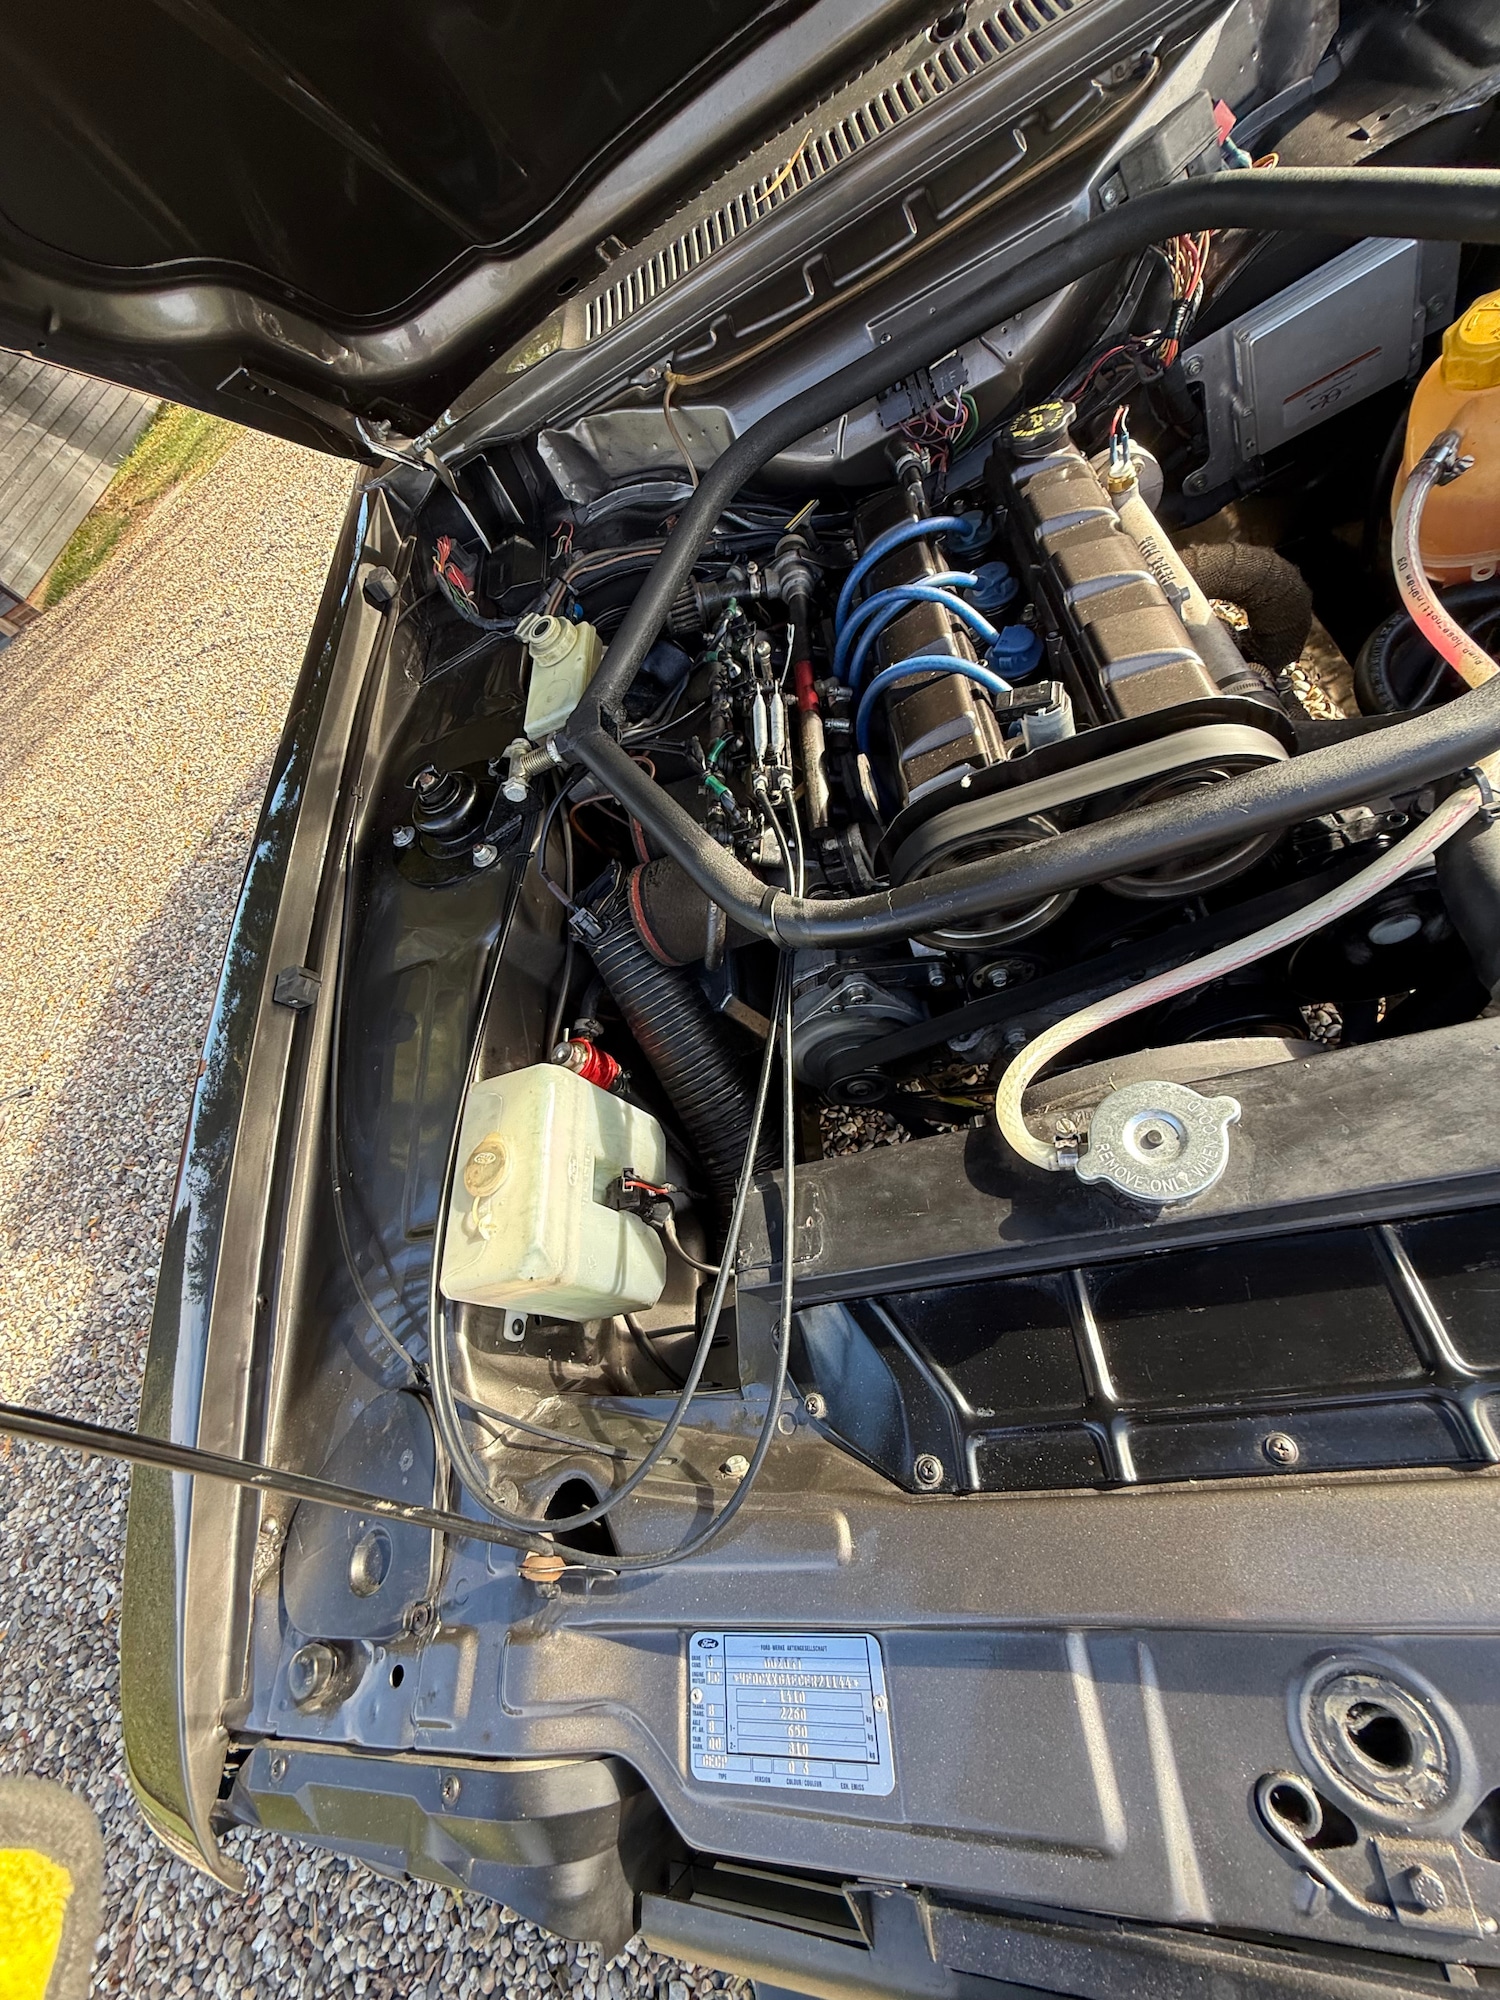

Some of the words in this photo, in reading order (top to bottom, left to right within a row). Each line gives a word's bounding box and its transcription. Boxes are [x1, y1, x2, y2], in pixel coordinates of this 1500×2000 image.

[1187, 1100, 1218, 1135] COLD
[1096, 1143, 1145, 1189] REMOVE
[1192, 1140, 1220, 1178] WHEN
[1150, 1171, 1194, 1193] ONLY
[699, 1638, 718, 1648] Ford
[780, 1707, 807, 1721] 2260
[866, 1715, 872, 1724] kg
[788, 1723, 808, 1739] 650
[867, 1733, 874, 1742] kg
[869, 1751, 876, 1760] kg
